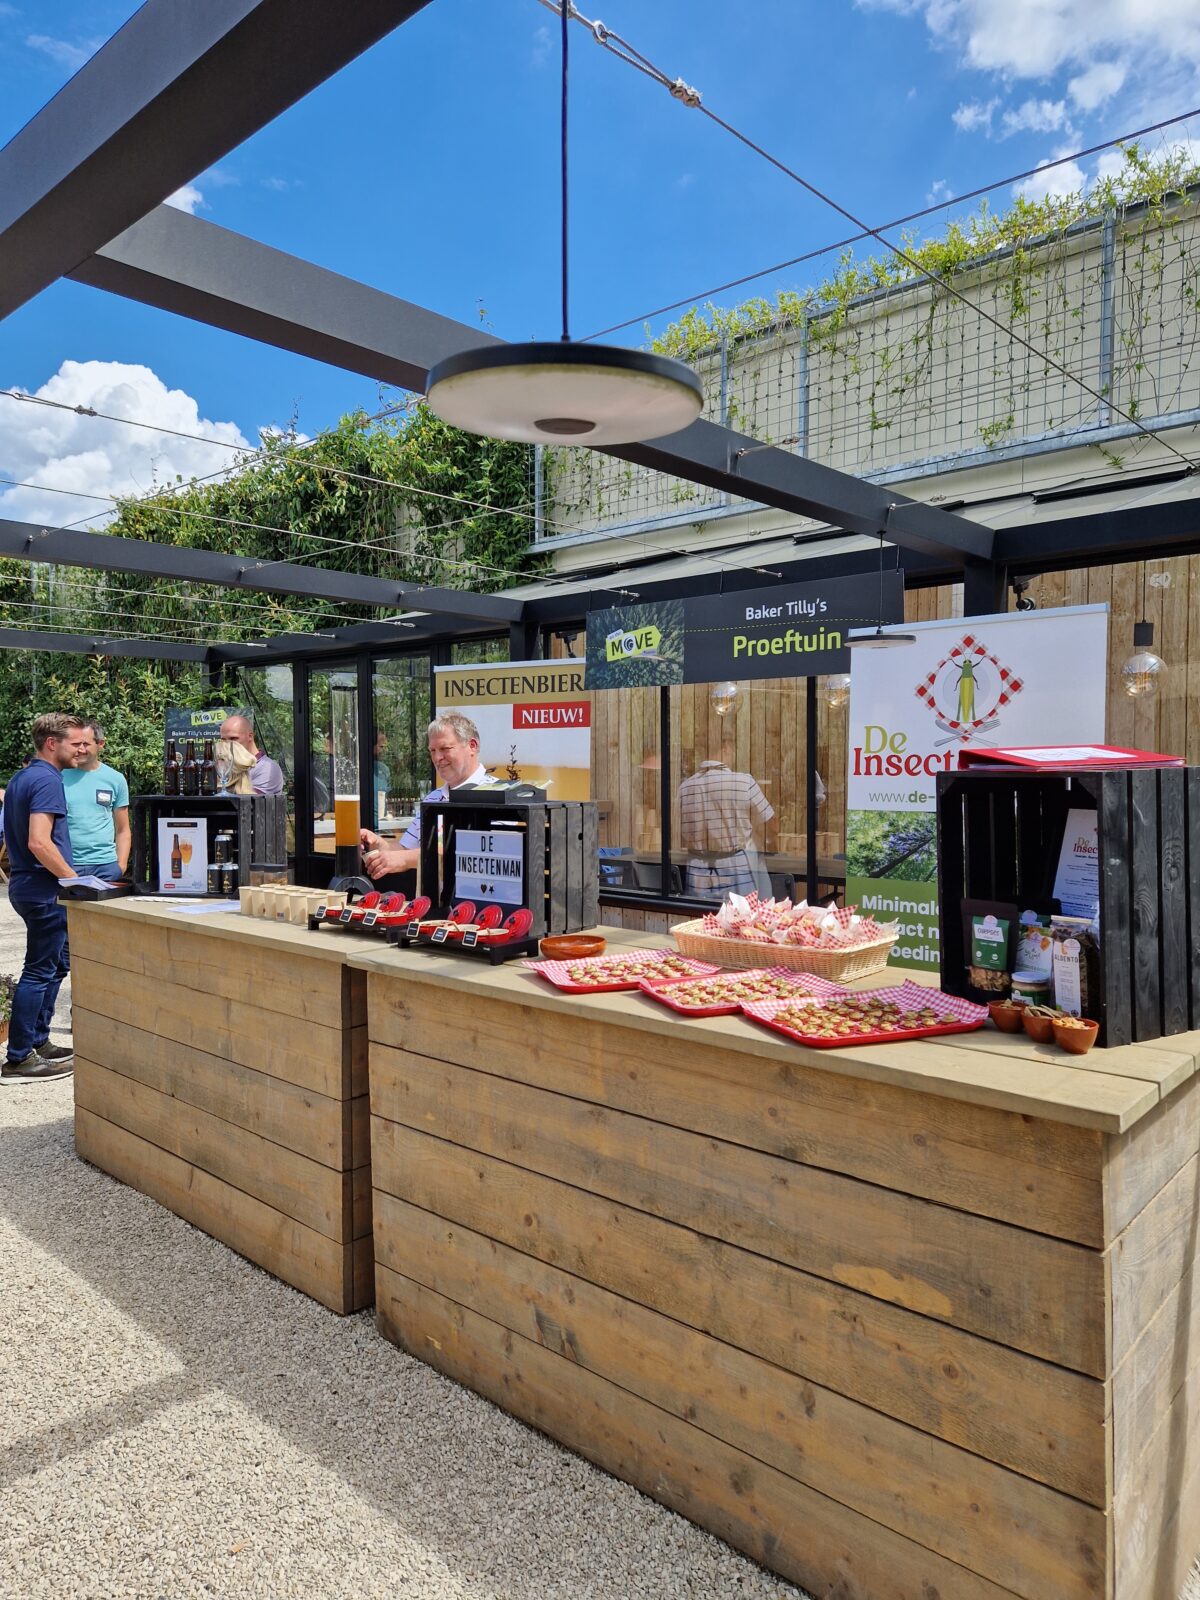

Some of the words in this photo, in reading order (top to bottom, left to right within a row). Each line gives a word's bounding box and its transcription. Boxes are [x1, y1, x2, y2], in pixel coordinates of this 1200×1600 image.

[744, 604, 782, 621] Baker
[785, 598, 828, 619] Tilly's
[611, 631, 654, 657] MOVE
[732, 626, 842, 658] Proeftuin
[443, 673, 585, 698] INSECTENBIER
[194, 712, 223, 723] MOVE
[521, 707, 584, 724] NIEUW!
[863, 725, 908, 755] De
[480, 835, 494, 852] DE
[458, 855, 522, 878] INSECTENMAN
